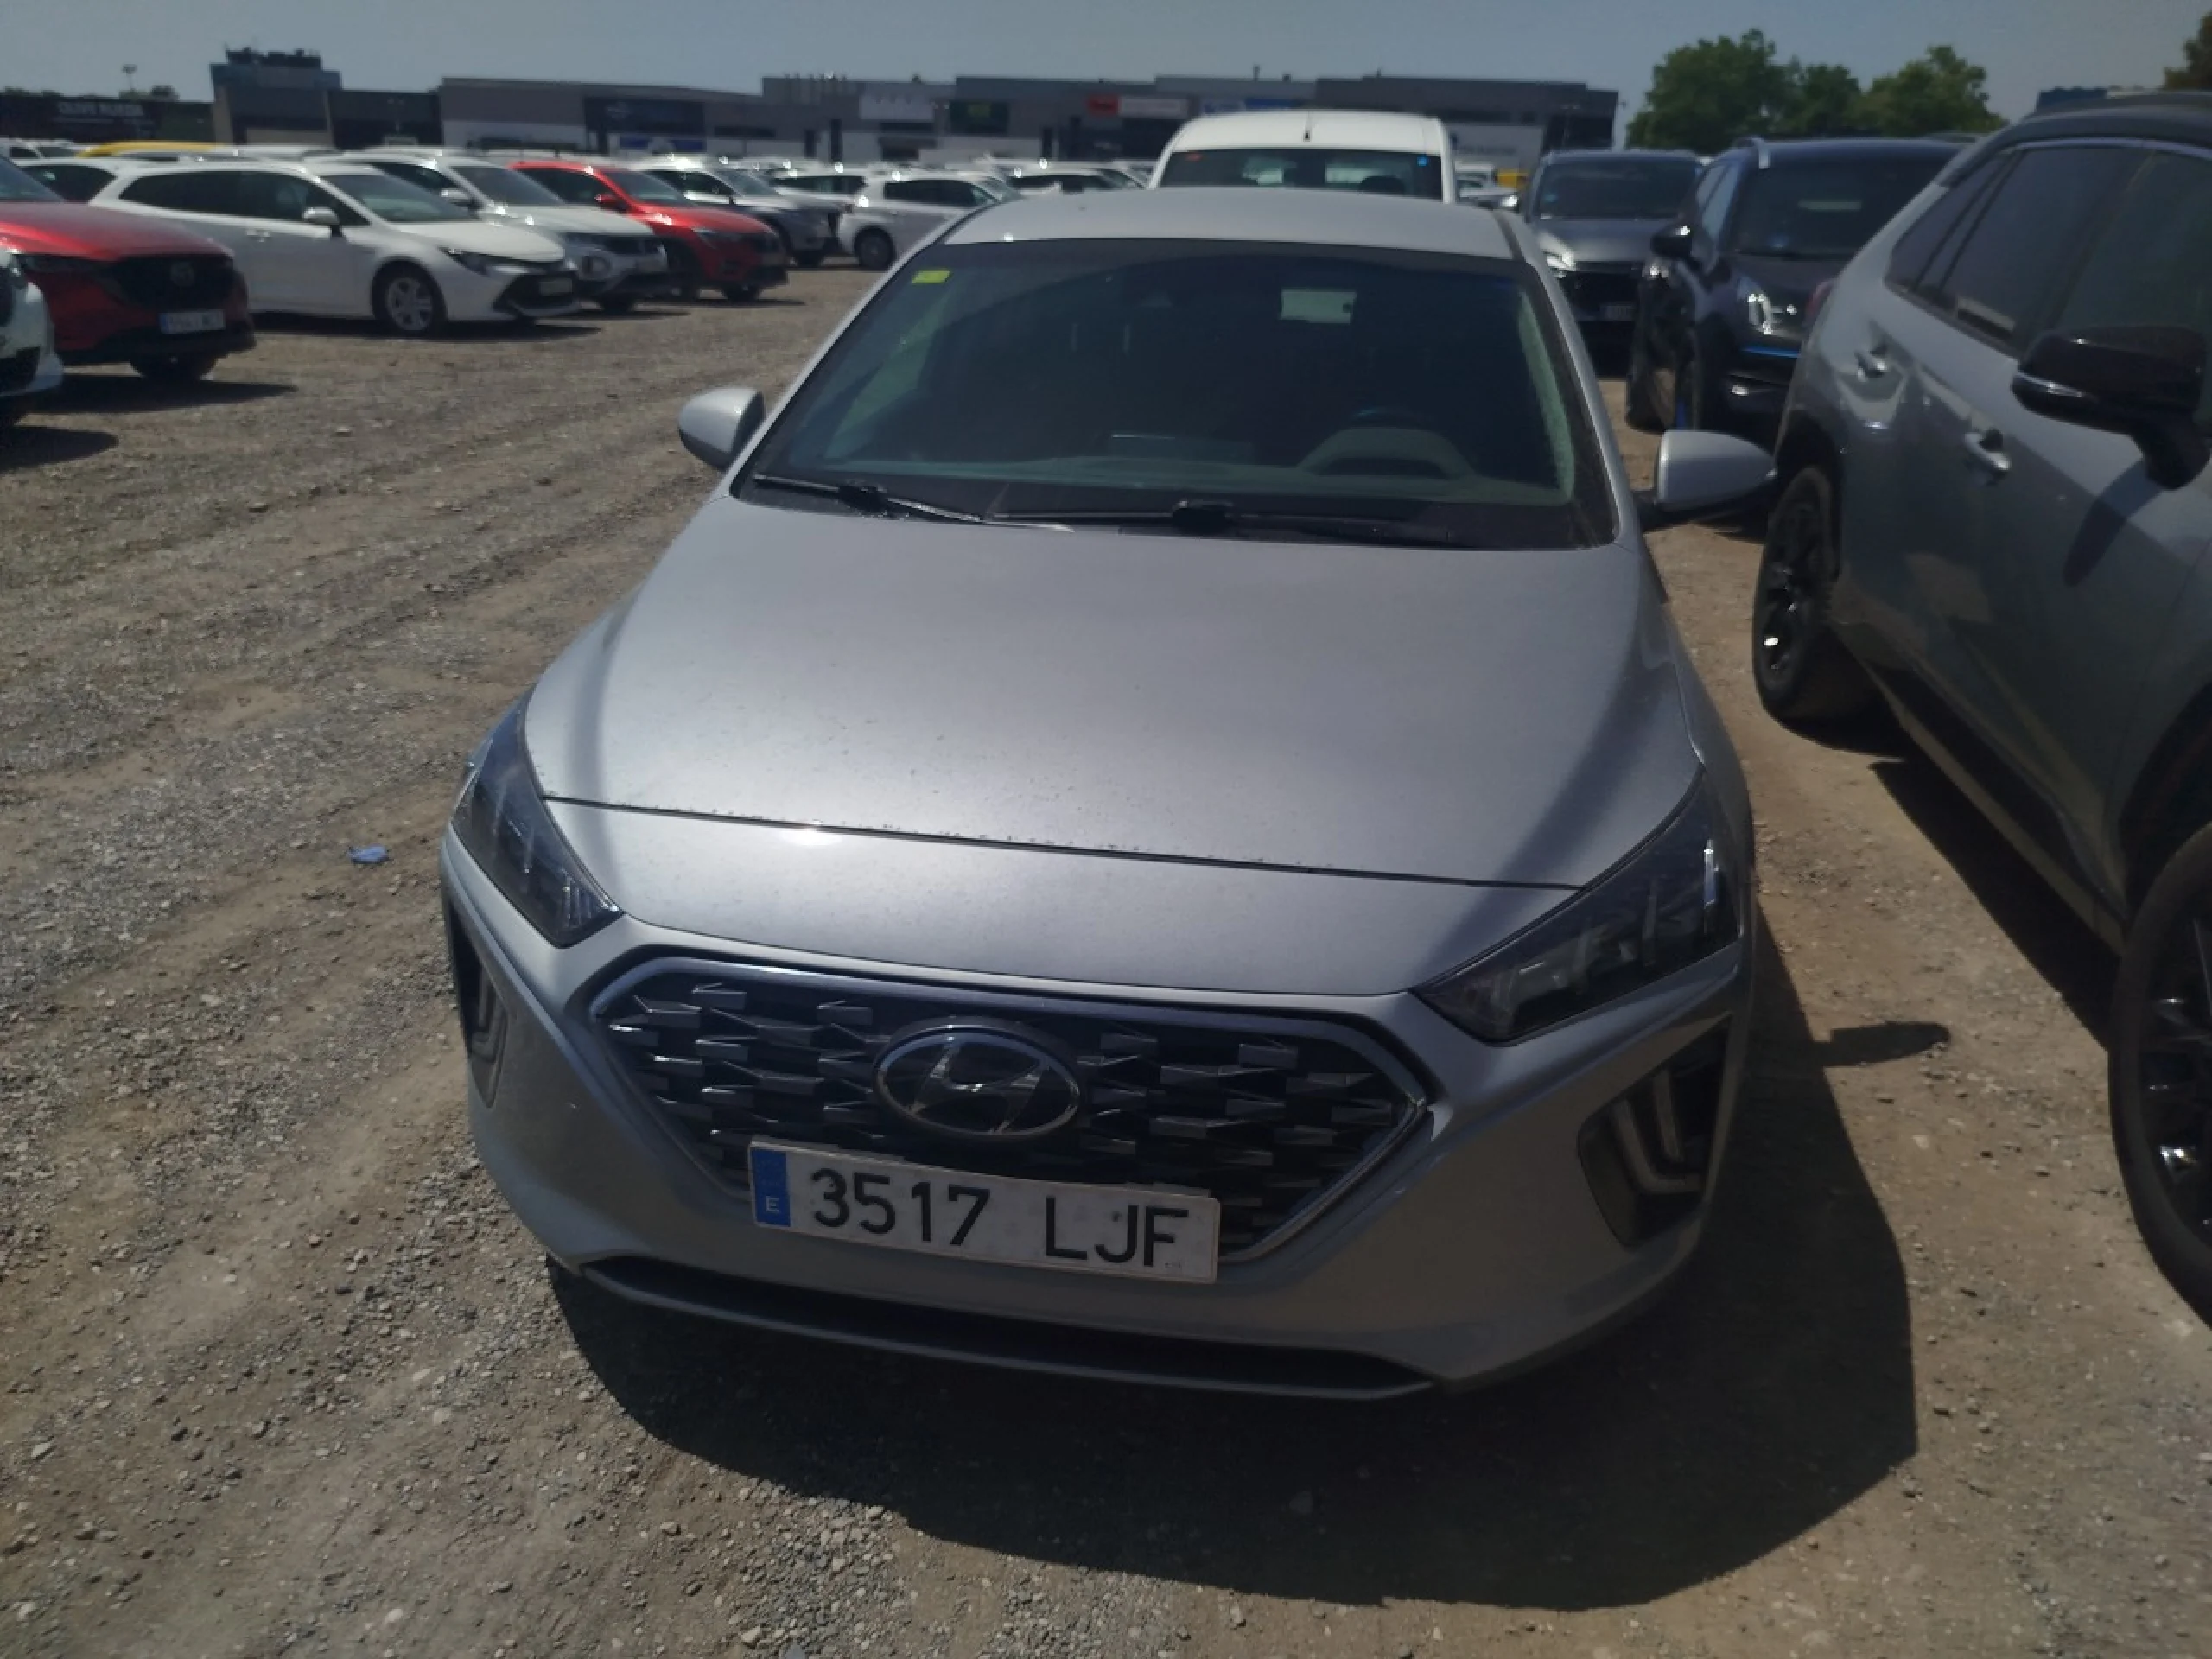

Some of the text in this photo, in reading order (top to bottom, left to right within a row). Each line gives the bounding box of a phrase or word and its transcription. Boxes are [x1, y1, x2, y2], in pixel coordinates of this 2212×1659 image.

[765, 1195, 780, 1213] E
[810, 1166, 1189, 1267] 3517 LJF
